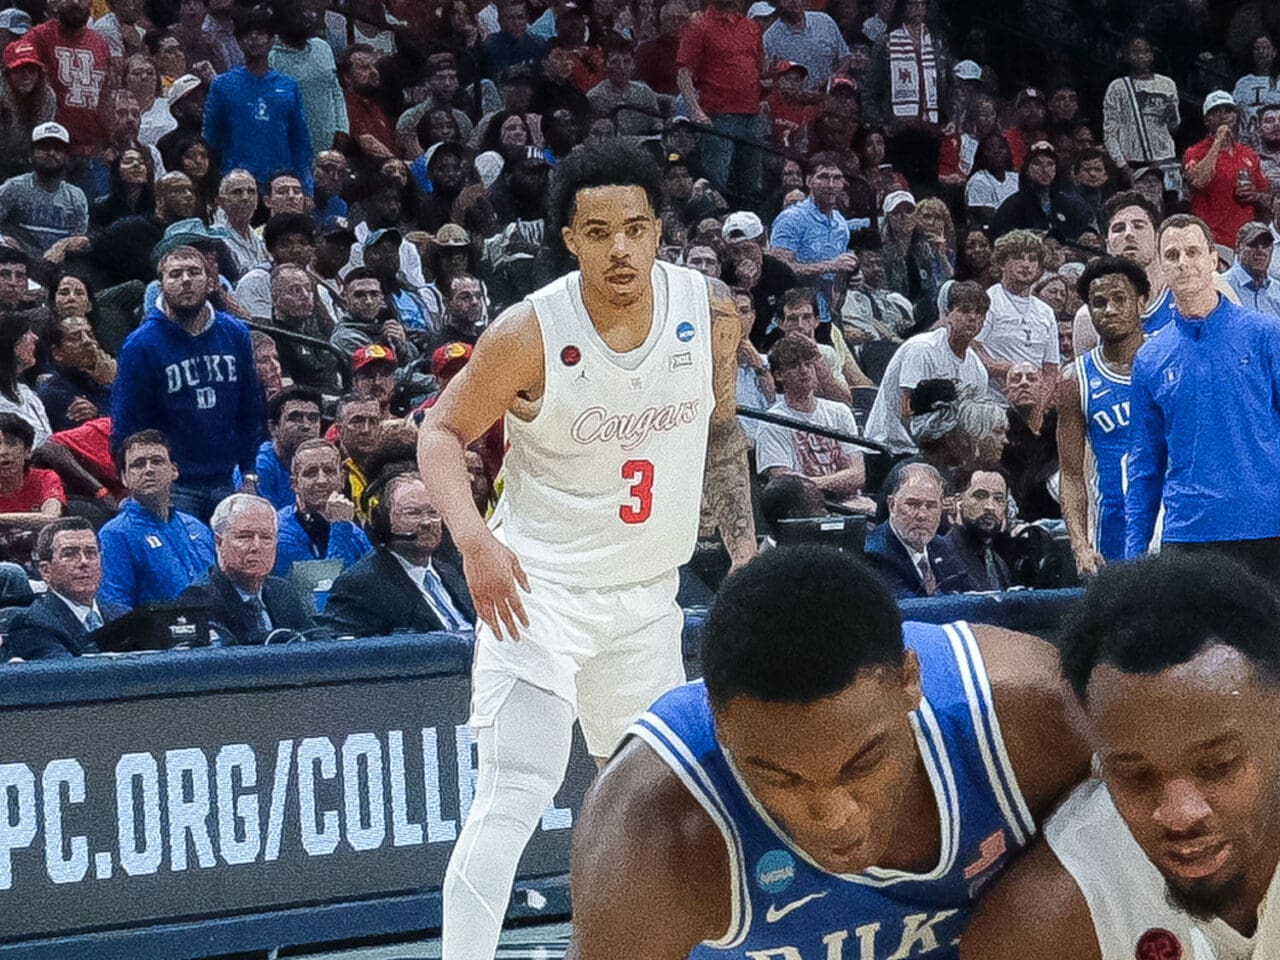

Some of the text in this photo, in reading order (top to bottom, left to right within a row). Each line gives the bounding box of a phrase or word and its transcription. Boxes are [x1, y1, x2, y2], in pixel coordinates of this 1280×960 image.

[165, 354, 238, 393] DUKE
[571, 398, 699, 450] Cougars
[619, 459, 655, 524] 3
